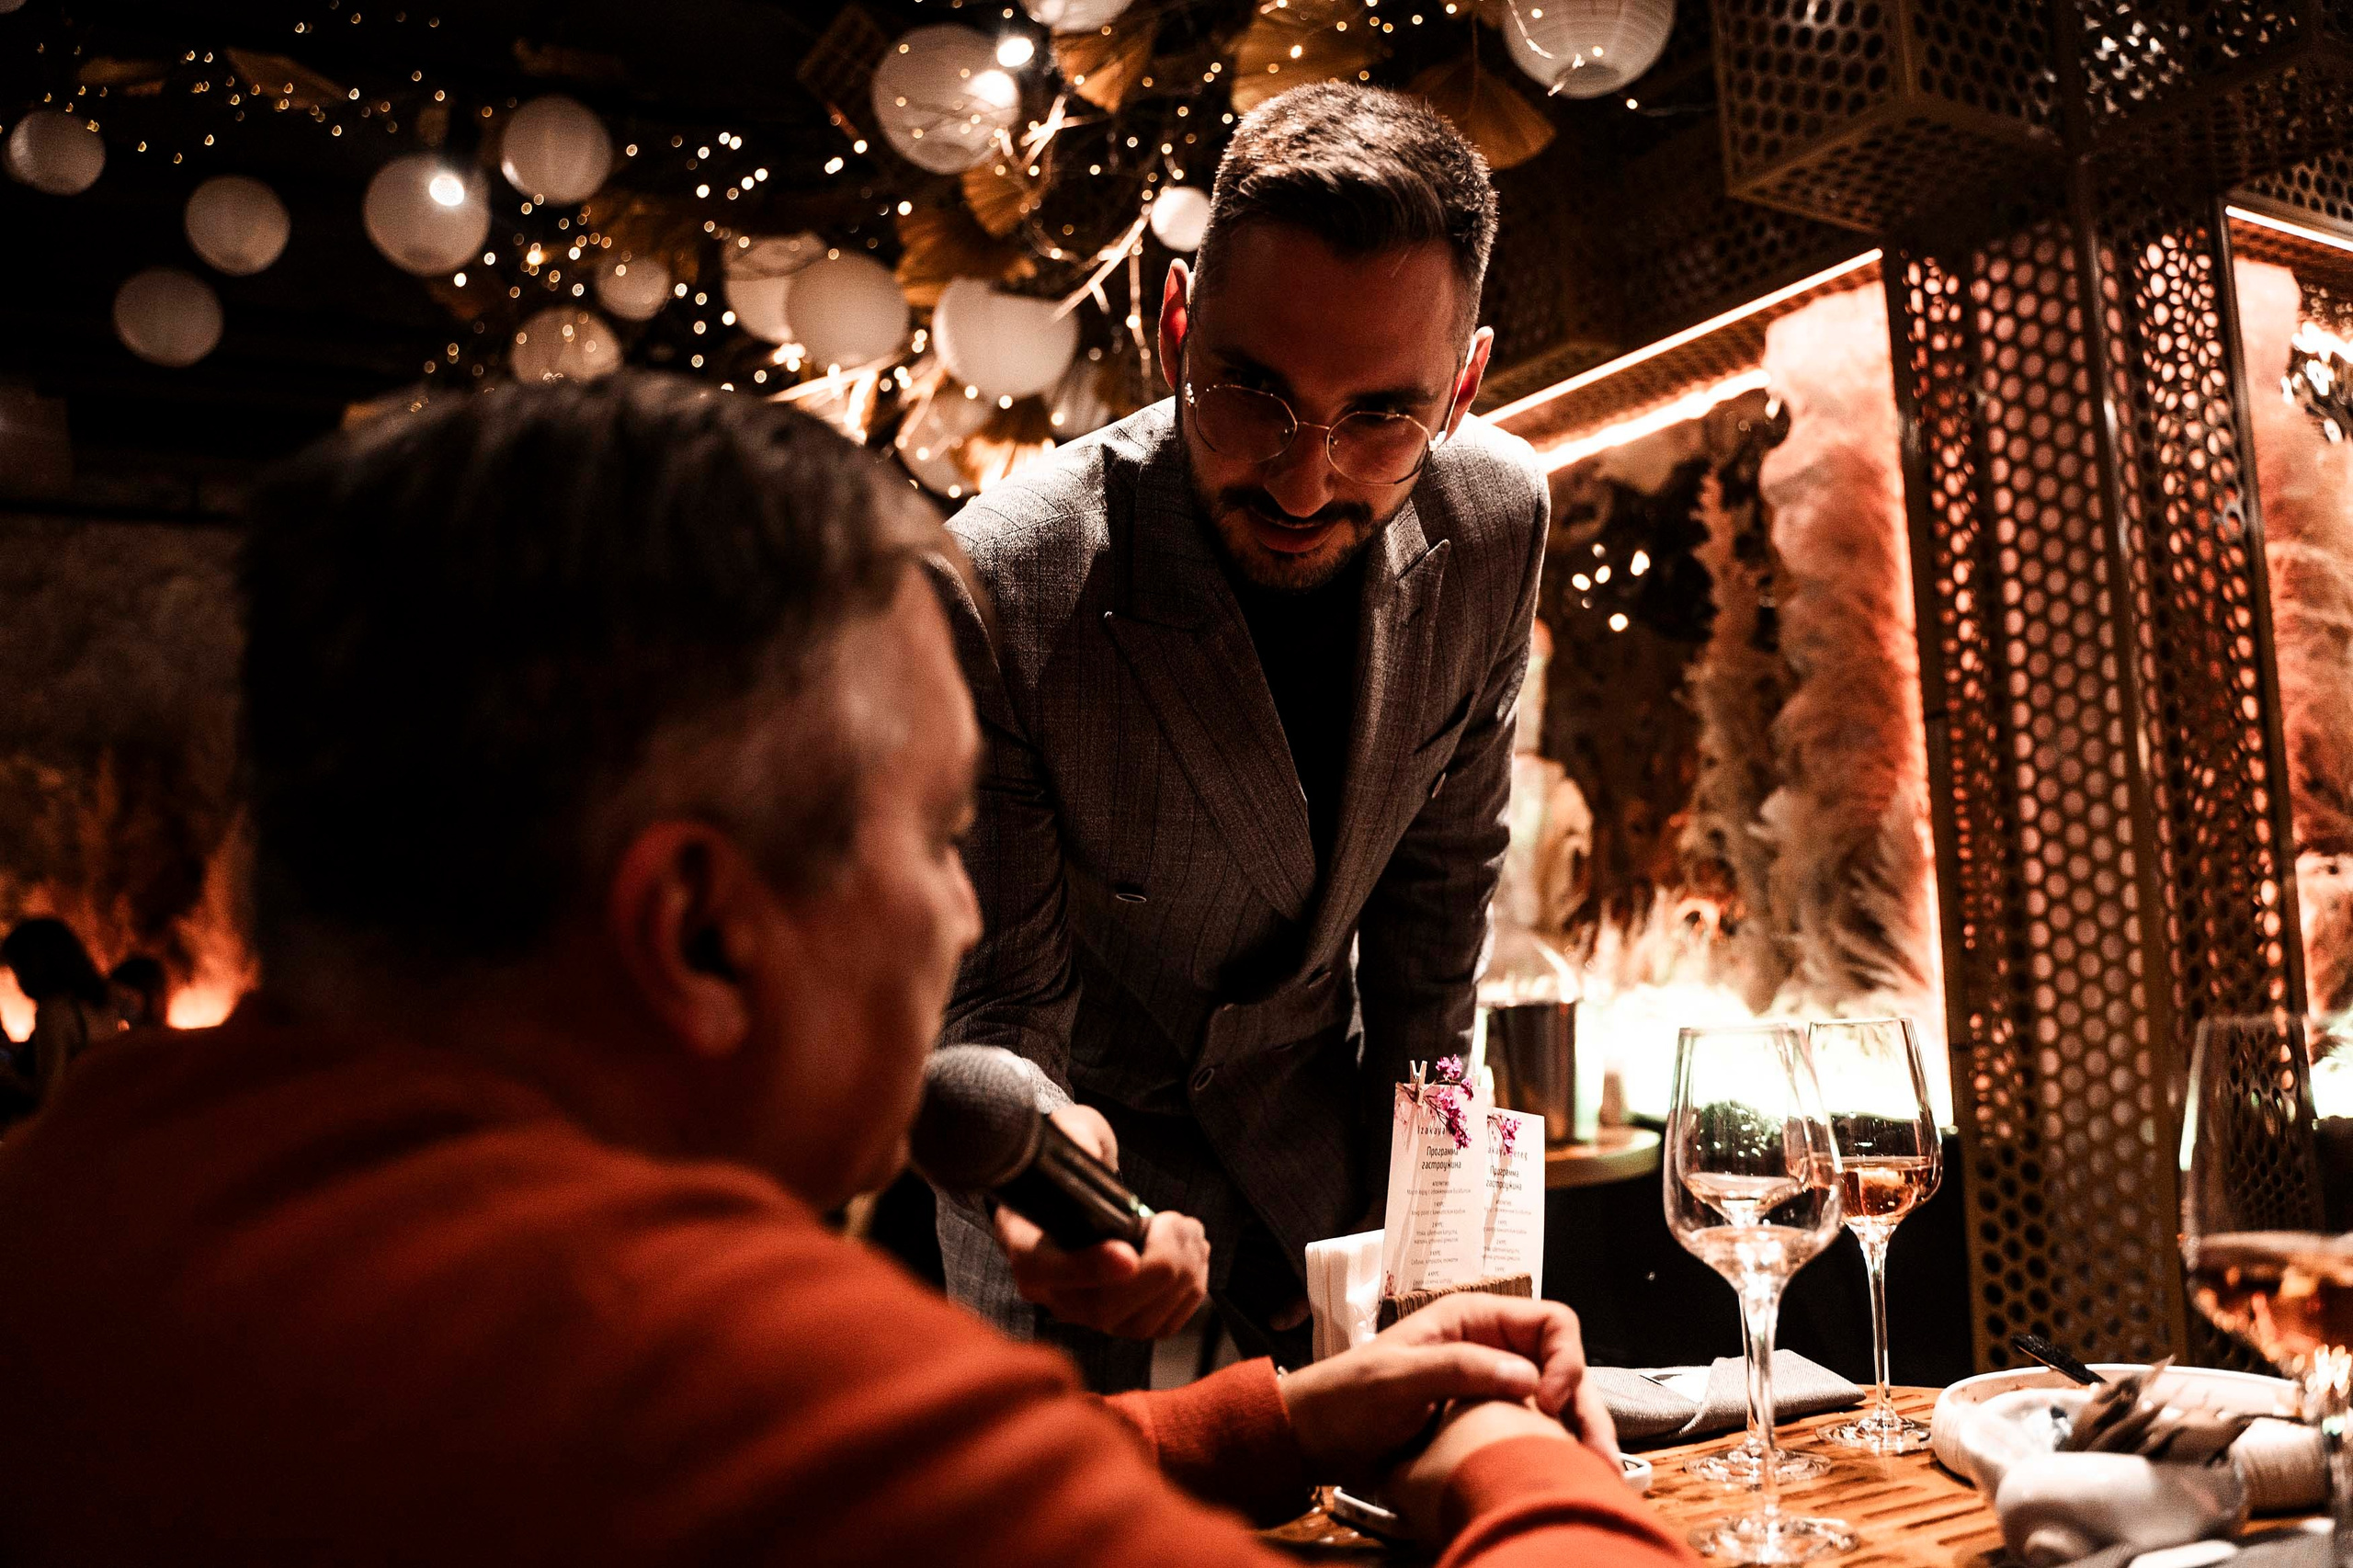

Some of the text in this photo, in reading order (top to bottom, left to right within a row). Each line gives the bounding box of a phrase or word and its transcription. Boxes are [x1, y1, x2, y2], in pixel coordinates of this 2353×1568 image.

[1417, 1124, 1446, 1136] Izakaya
[1426, 1145, 1459, 1158] Программа
[1513, 1150, 1528, 1161] ereg
[1421, 1159, 1461, 1172] гастроужина
[1489, 1165, 1519, 1178] Программа
